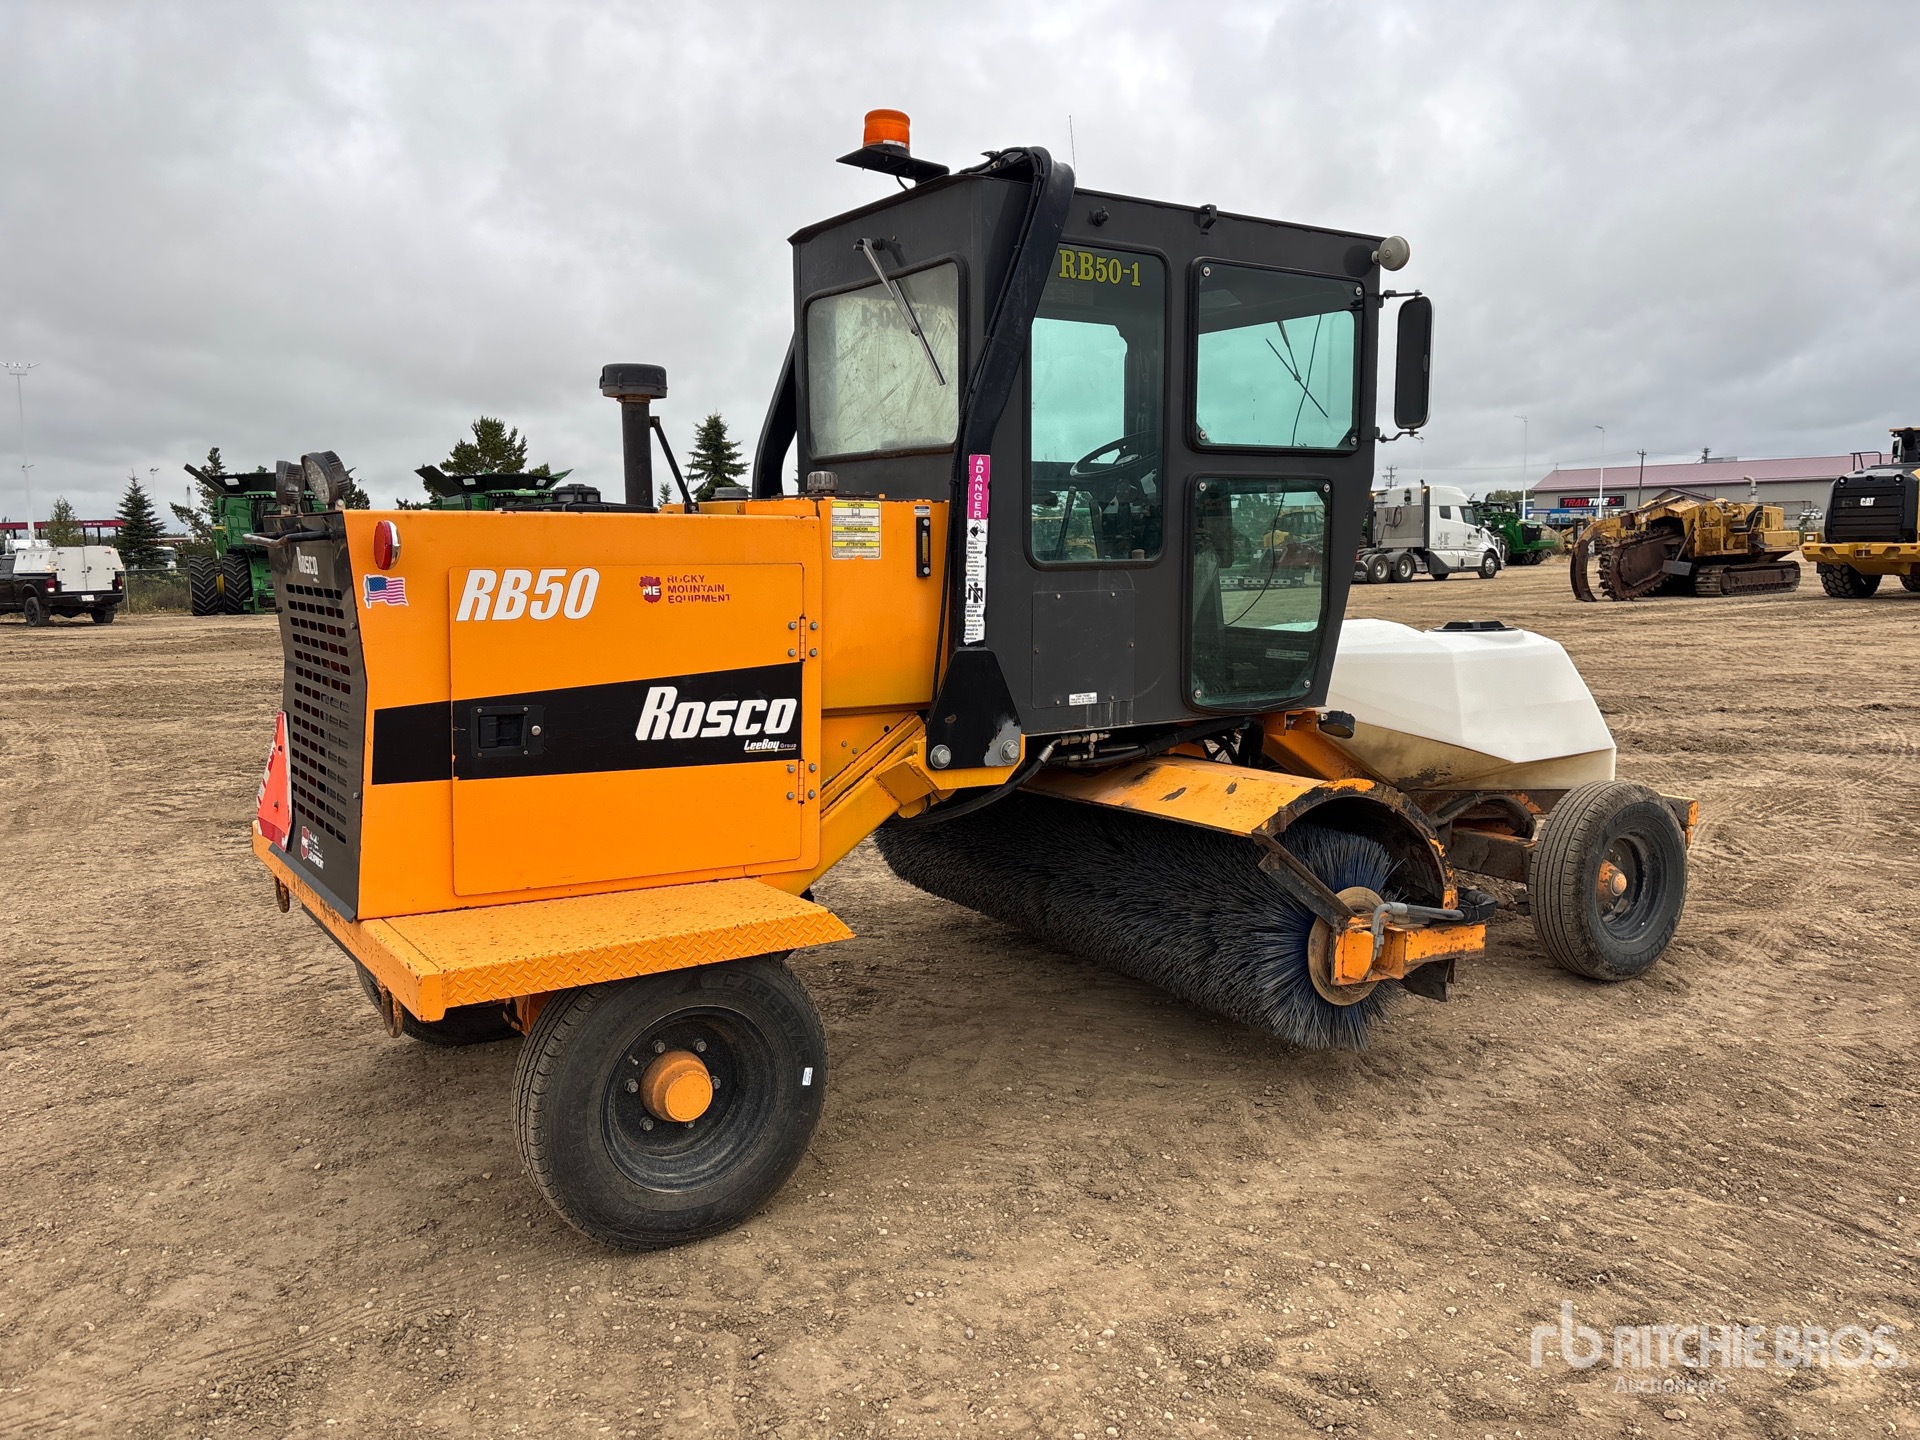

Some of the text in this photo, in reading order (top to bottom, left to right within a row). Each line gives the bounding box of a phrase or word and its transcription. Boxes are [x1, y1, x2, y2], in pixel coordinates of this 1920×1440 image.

[1058, 248, 1141, 287] RB50-1
[973, 465, 984, 519] DANGER
[1860, 497, 1875, 507] CAT
[455, 567, 600, 622] RB50
[667, 584, 725, 594] MOUNTAIN
[744, 738, 780, 752] LeeBoy
